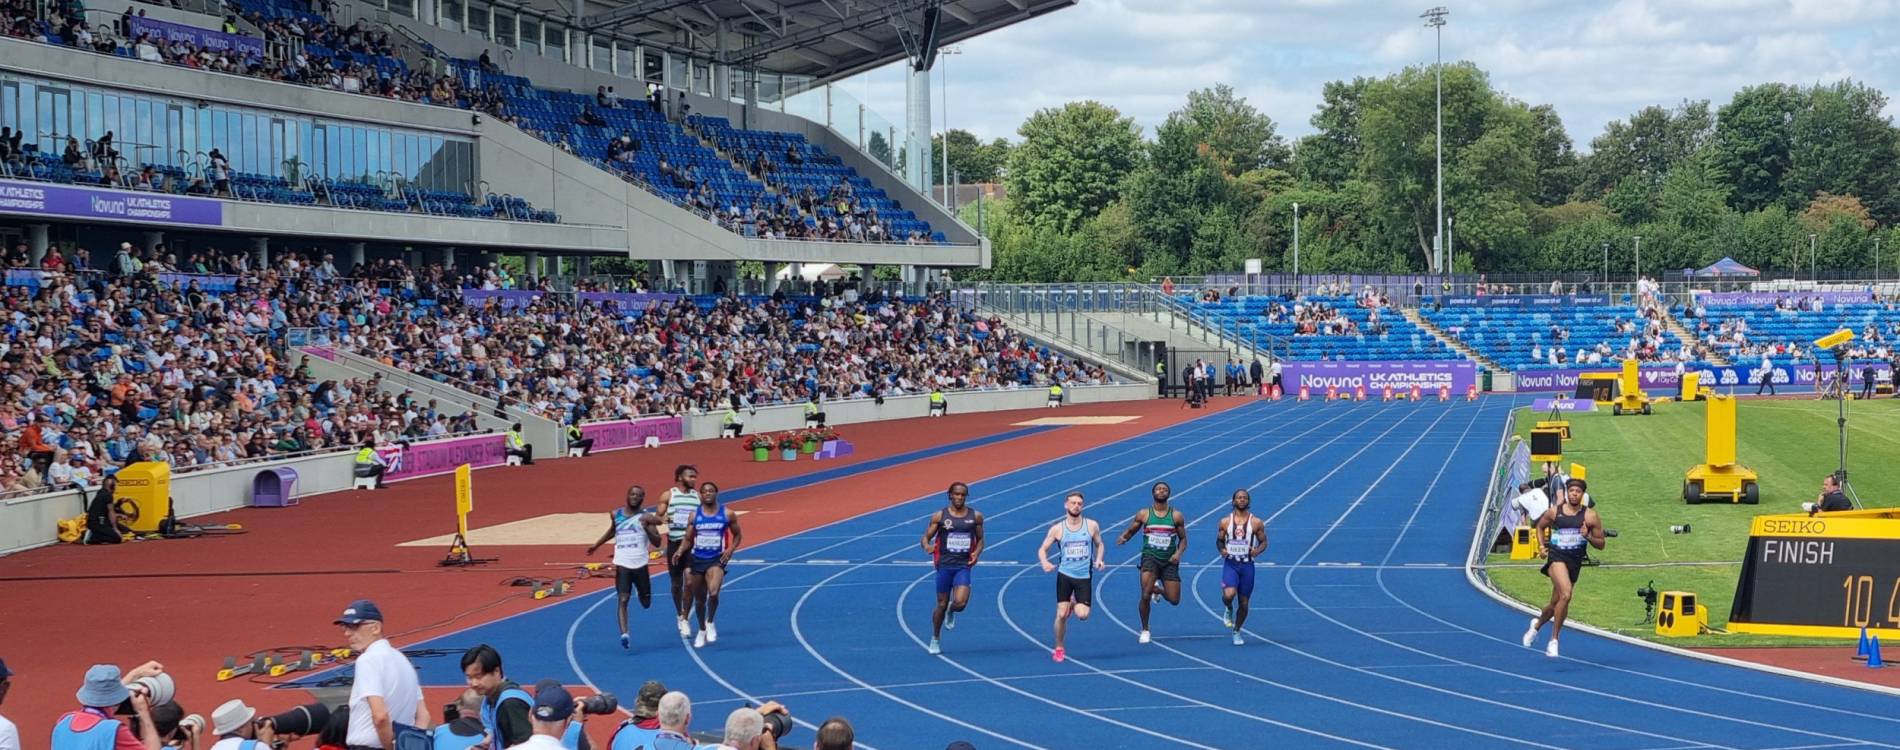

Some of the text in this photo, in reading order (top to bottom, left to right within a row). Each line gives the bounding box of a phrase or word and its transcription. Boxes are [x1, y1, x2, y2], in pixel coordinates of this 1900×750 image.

[91, 195, 125, 214] Novuna
[127, 197, 171, 210] UK ATHLETICS
[127, 208, 171, 219] CHAMPIONSHIPS
[1703, 296, 1737, 305] Novuna
[1833, 295, 1868, 304] Novuna
[1722, 368, 1736, 377] VITA
[1772, 368, 1786, 377] VITA
[1300, 373, 1452, 388] Novuna UK ATHLETICS
[1518, 374, 1552, 388] Novuna
[1720, 376, 1738, 384] COCO
[1771, 376, 1789, 384] COCO
[1547, 402, 1575, 410] Nvuna
[1764, 520, 1826, 534] SEIKO
[1763, 540, 1835, 565] FINISH
[1843, 575, 1900, 628] 10.4
